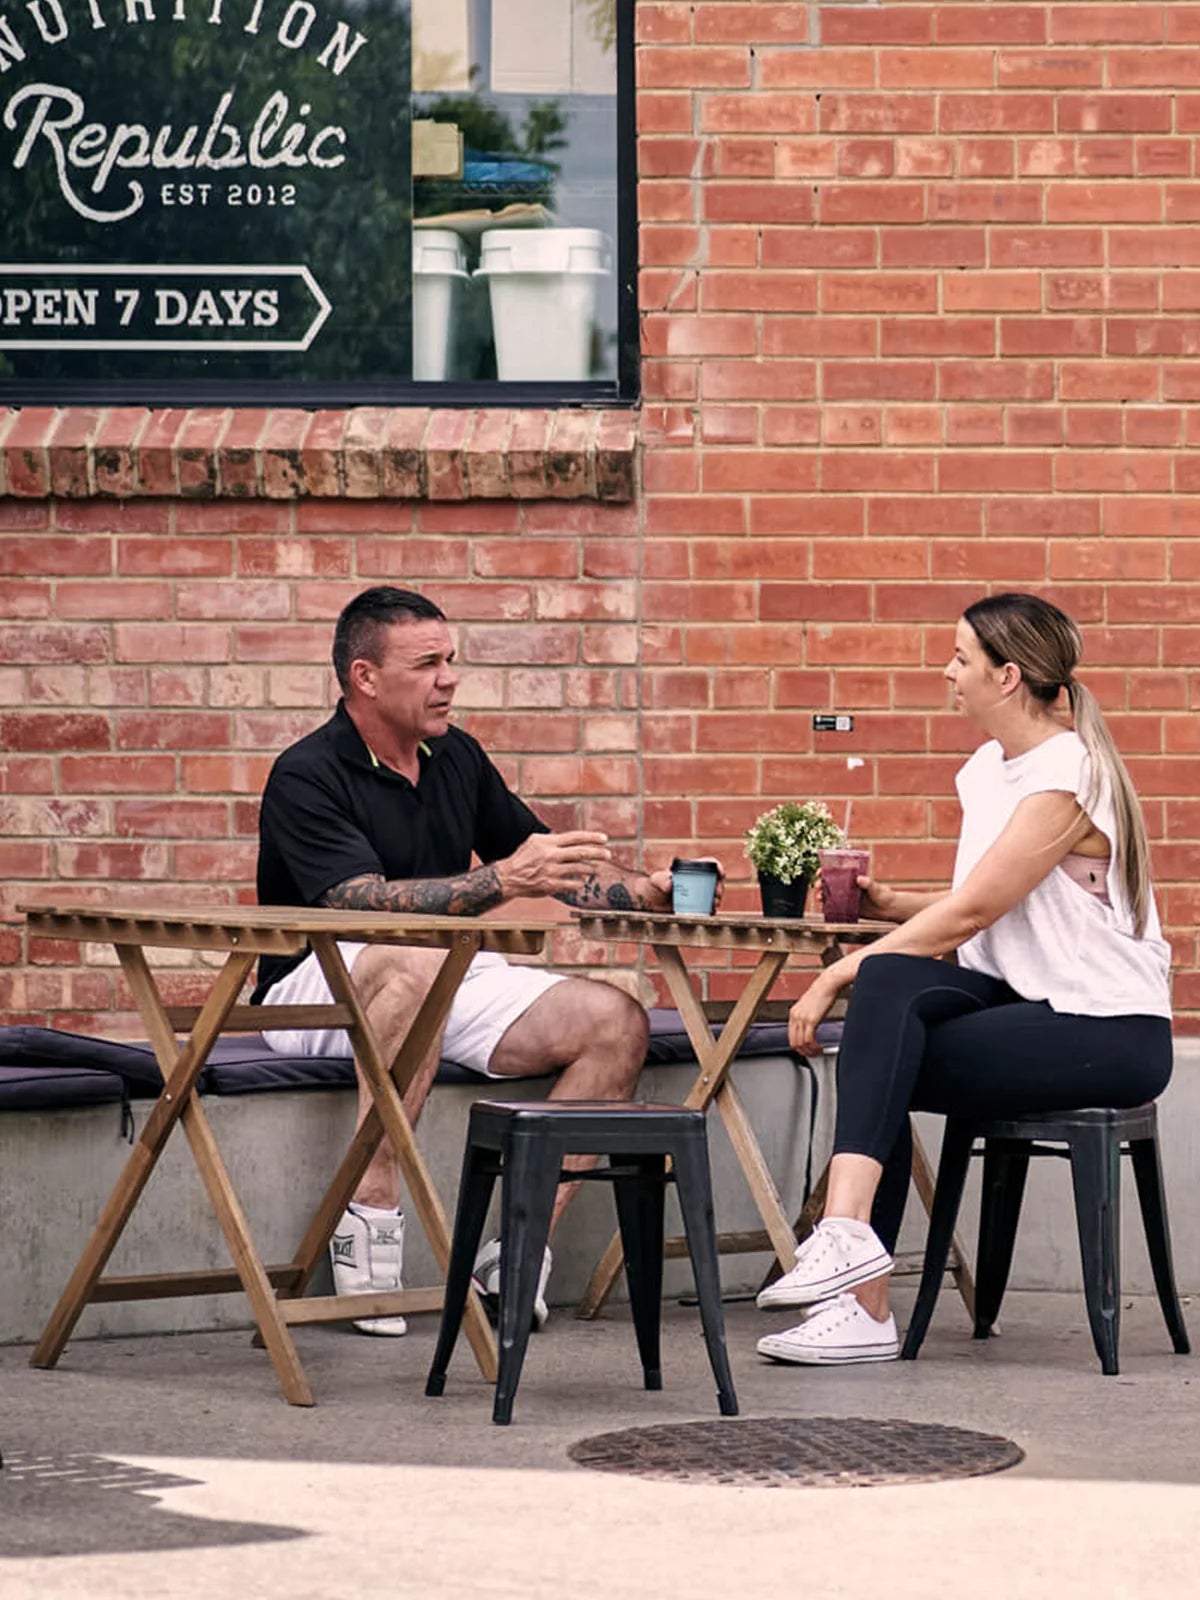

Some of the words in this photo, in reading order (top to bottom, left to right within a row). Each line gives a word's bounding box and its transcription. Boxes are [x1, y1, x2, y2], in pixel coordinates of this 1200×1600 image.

[3, 83, 346, 222] Republic
[161, 183, 212, 205] EST
[227, 184, 296, 206] 2012
[0, 289, 99, 325] PEN
[115, 289, 140, 325] 7
[155, 289, 279, 326] DAYS
